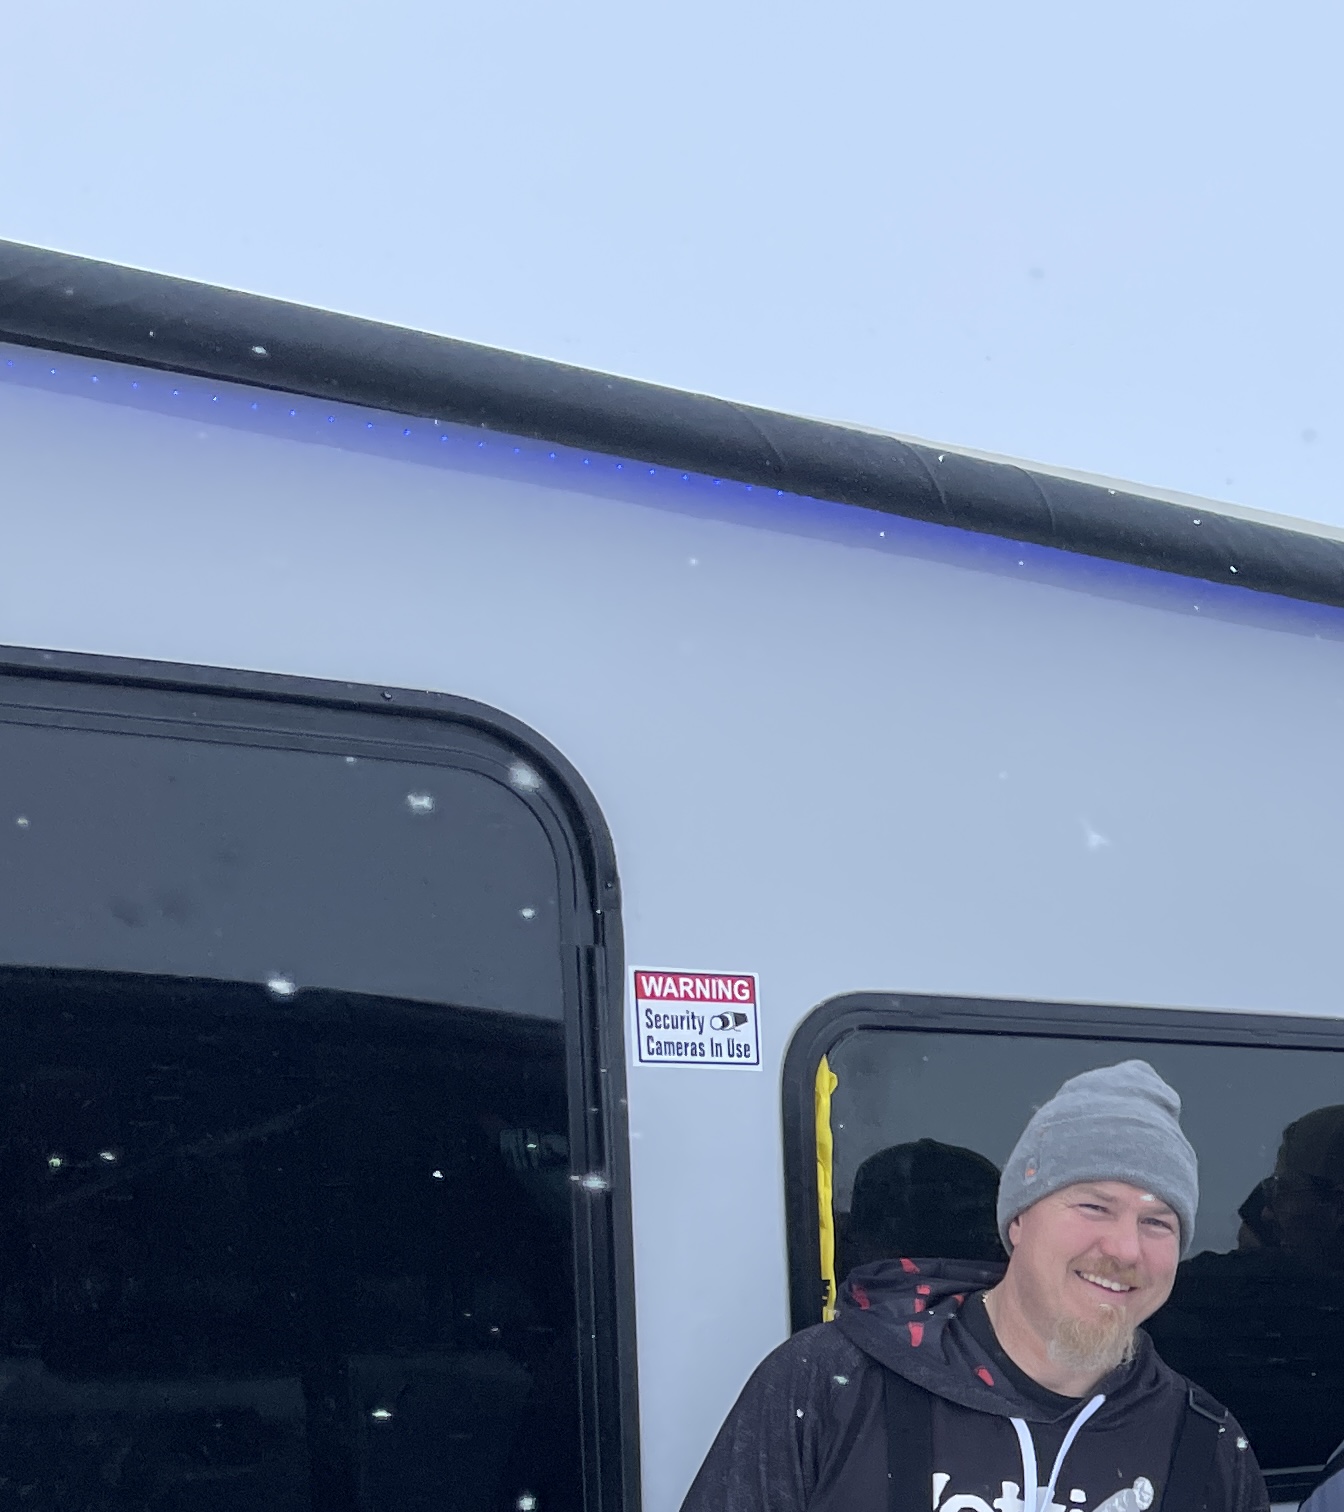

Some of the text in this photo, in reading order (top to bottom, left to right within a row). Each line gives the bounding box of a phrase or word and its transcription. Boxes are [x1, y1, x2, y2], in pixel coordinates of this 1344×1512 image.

[640, 975, 751, 1001] WARNING
[645, 1007, 705, 1035] Security
[646, 1035, 751, 1059] Cameras In Use
